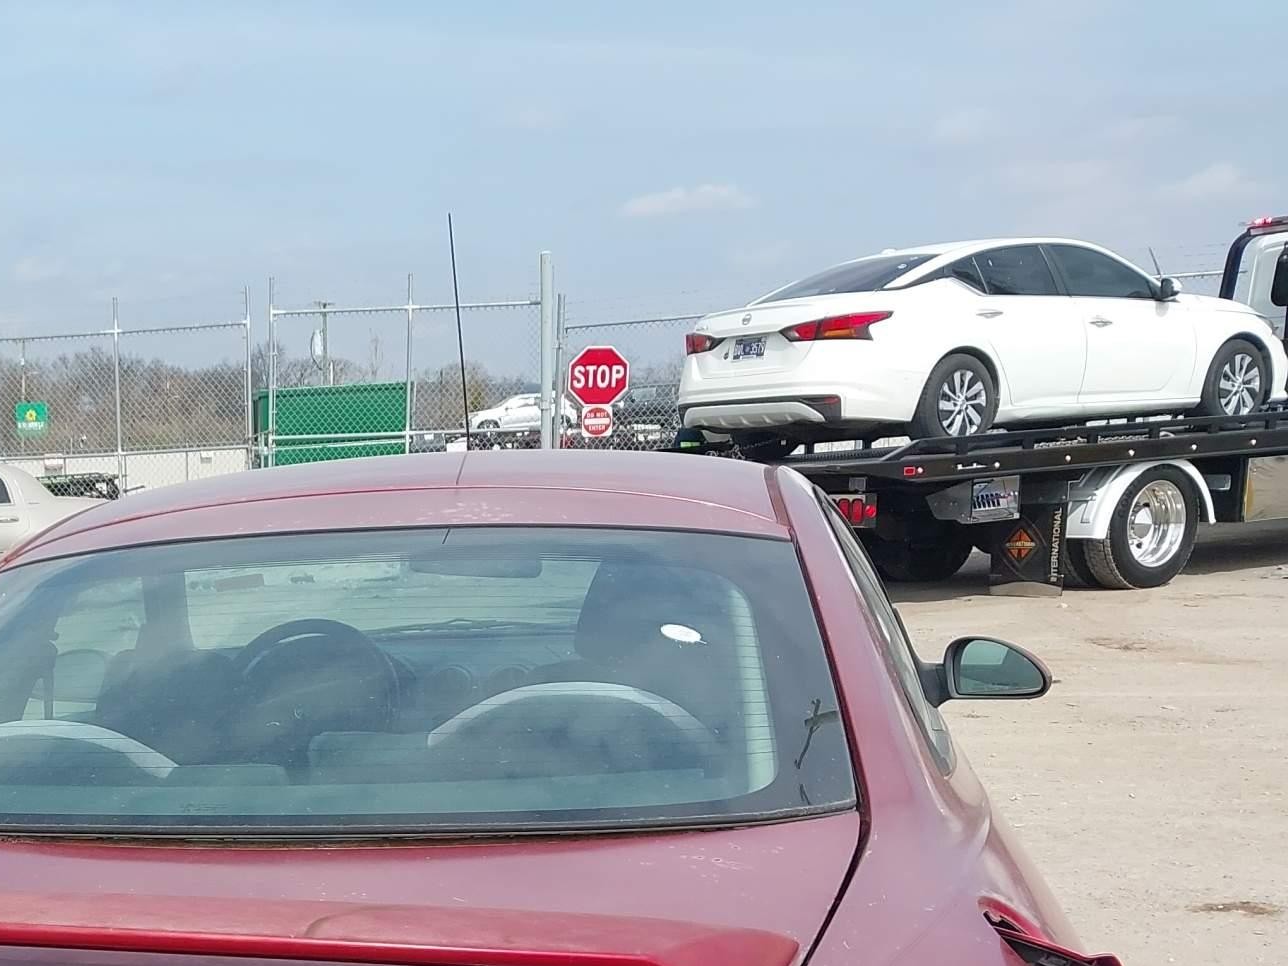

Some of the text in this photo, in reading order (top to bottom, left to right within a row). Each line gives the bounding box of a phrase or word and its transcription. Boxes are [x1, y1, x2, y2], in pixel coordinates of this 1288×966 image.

[573, 365, 624, 388] STOP
[588, 424, 606, 432] ENTER
[1050, 507, 1063, 582] INTERNATIONAL
